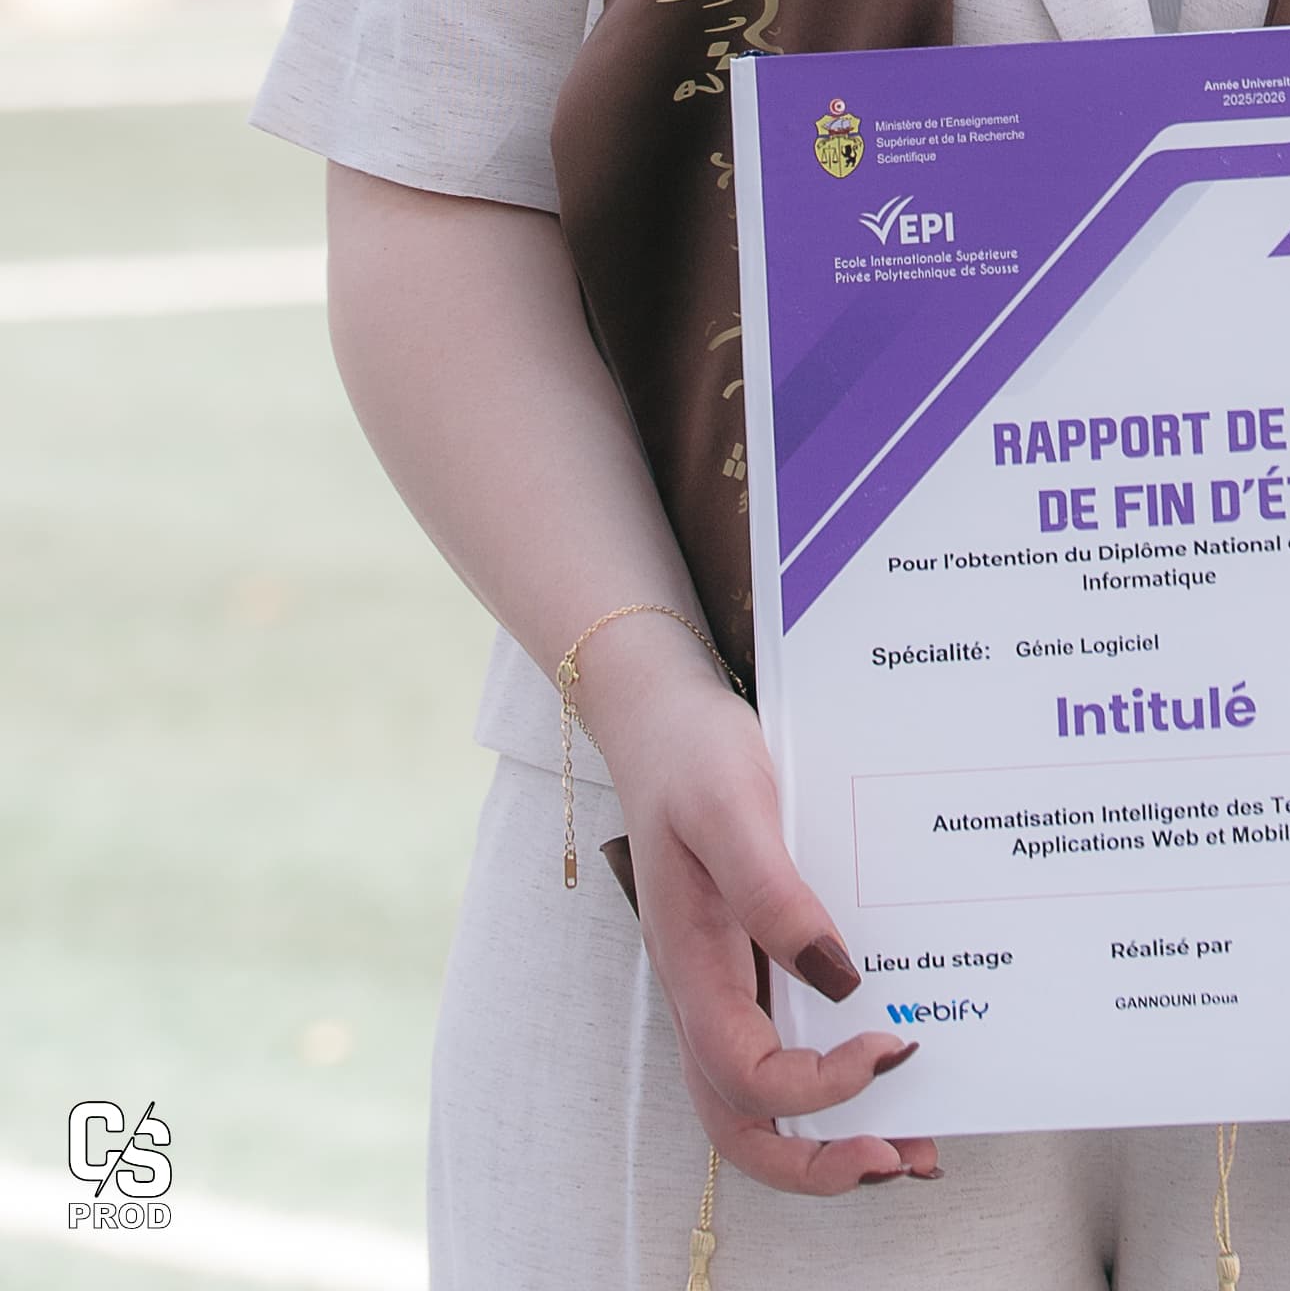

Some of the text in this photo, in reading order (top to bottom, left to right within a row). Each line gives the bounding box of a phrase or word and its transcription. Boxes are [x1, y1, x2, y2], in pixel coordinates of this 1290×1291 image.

[1204, 80, 1239, 91] Année
[1223, 91, 1286, 106] 2025/2026
[876, 114, 1019, 131] Ministère de l'Enseignement
[876, 129, 1025, 149] Supérieur et de la Recherche
[877, 152, 936, 164] Scientifique
[835, 249, 1018, 269] Ecole Internationale Supérieure
[835, 263, 1019, 283] Privée Polytechnique de Sousse
[992, 411, 1211, 467] RAPPORT
[1226, 407, 1288, 454] DE
[1038, 487, 1099, 534] DE
[1113, 481, 1195, 529] FIN
[889, 558, 937, 572] Pour
[943, 547, 1058, 570] l'obtention
[1065, 547, 1091, 562] du
[1098, 542, 1187, 564] Diplôme
[1193, 535, 1281, 556] National
[1082, 568, 1217, 591] Informatique
[870, 640, 992, 668] Spécialité:
[1015, 634, 1159, 658] Génie Logiciel
[1055, 680, 1258, 739] Intitulé
[931, 807, 1096, 833] Automatisation
[1102, 802, 1219, 825] Intelligente
[1226, 798, 1264, 817] des
[1012, 833, 1145, 859] Applications
[1151, 828, 1199, 848] Web
[1207, 829, 1224, 844] et
[864, 946, 1014, 973] Lieu du stage
[1110, 936, 1233, 960] Réalisé par
[886, 999, 989, 1024] Webify
[1116, 993, 1238, 1009] GANNOUNI Doua
